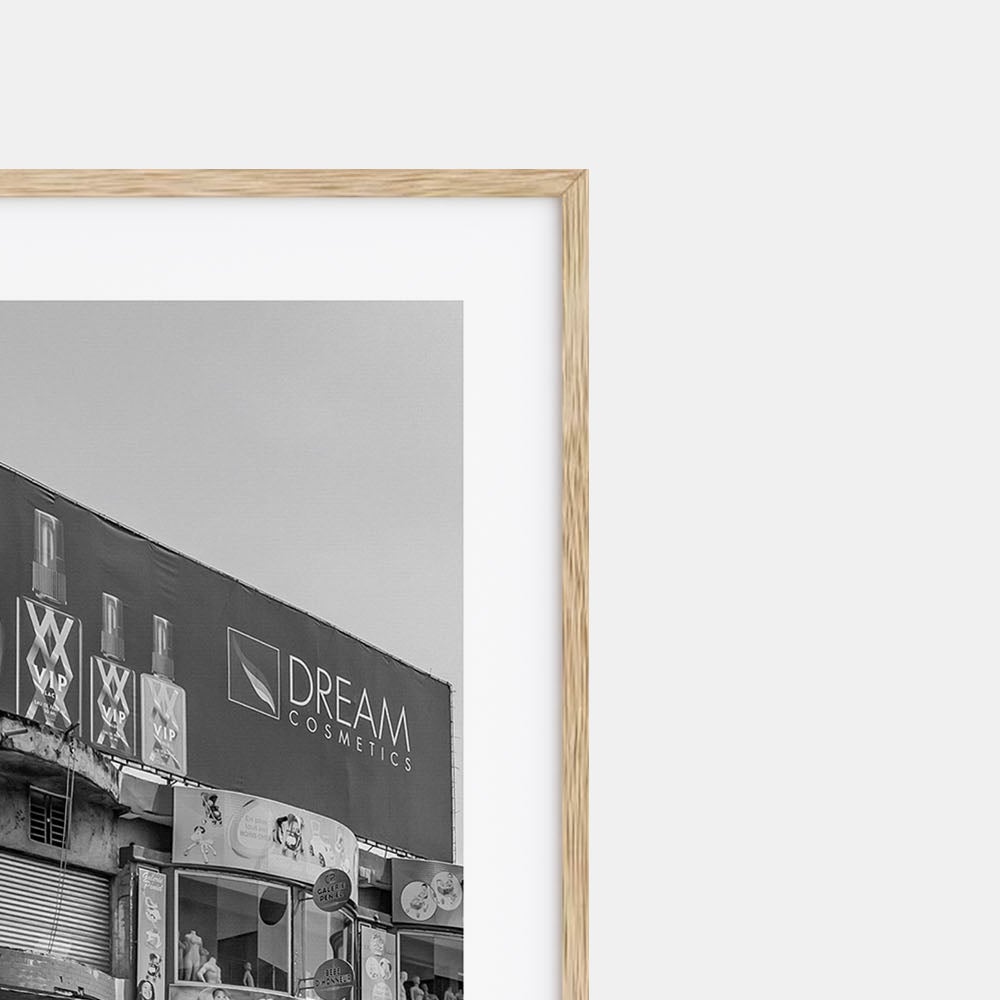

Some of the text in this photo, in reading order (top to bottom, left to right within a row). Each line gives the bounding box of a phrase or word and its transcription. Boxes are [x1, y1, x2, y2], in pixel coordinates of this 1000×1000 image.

[33, 664, 68, 692] VIP
[102, 703, 126, 724] VIP
[289, 654, 410, 753] DREAM
[153, 722, 176, 742] VIP
[288, 710, 412, 772] COSMETICS
